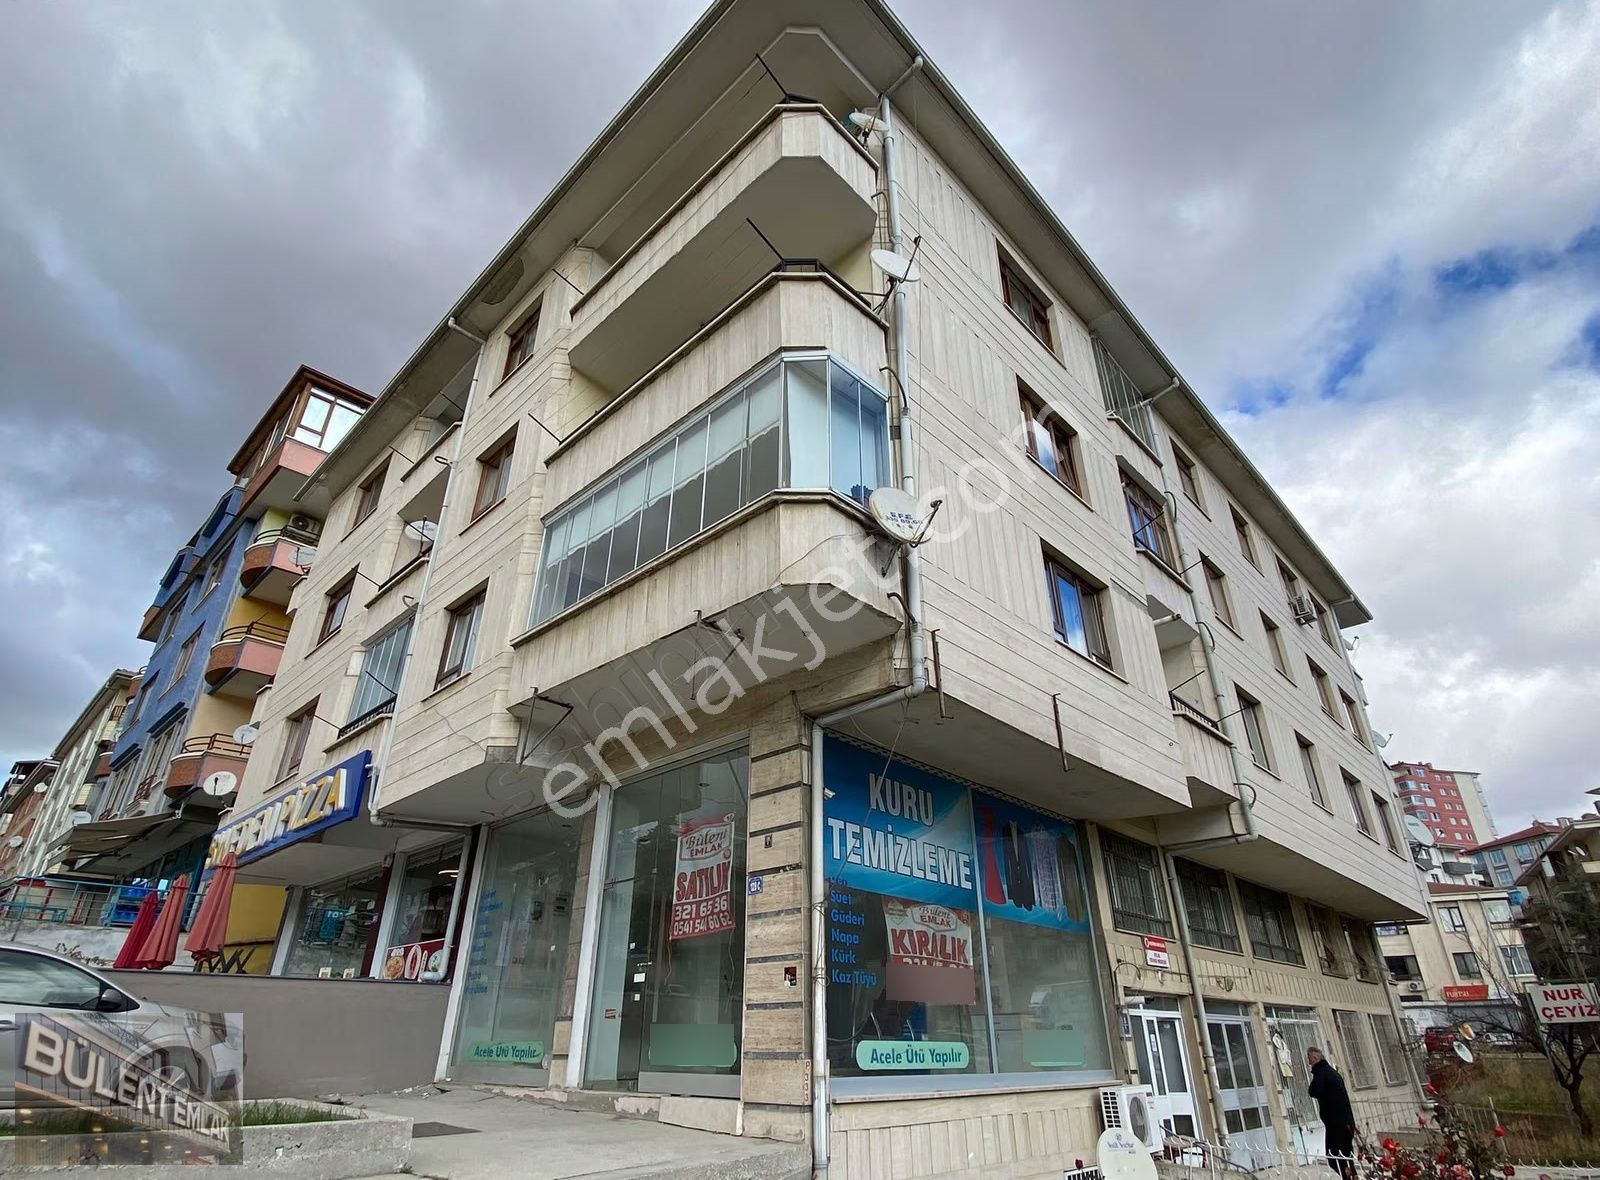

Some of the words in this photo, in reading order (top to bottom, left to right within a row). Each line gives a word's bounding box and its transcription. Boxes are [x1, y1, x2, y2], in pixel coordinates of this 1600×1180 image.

[869, 772, 935, 827] KURU
[685, 828, 728, 849] Bülent
[690, 843, 723, 858] EMLAK
[827, 817, 973, 890] TEMİZLEME
[676, 860, 731, 902] SATILIK
[675, 903, 696, 920] 321
[700, 901, 712, 916] 65
[713, 895, 727, 913] 36
[673, 918, 693, 936] 0541
[708, 915, 720, 930] 60
[830, 908, 865, 927] Güderi
[920, 915, 952, 928] EMLAK
[831, 929, 859, 946] Napa
[891, 928, 968, 964] KIRALIK
[831, 948, 856, 964] Kürk
[832, 969, 852, 984] Kaz
[852, 971, 877, 988] Tüyü
[1542, 988, 1584, 1001] NUR
[1541, 1003, 1599, 1022] ÇEYİZ
[474, 1046, 494, 1058] Acele
[870, 1048, 902, 1064] Acele
[906, 1044, 925, 1064] Ütü
[929, 1048, 962, 1067] Yapılır
